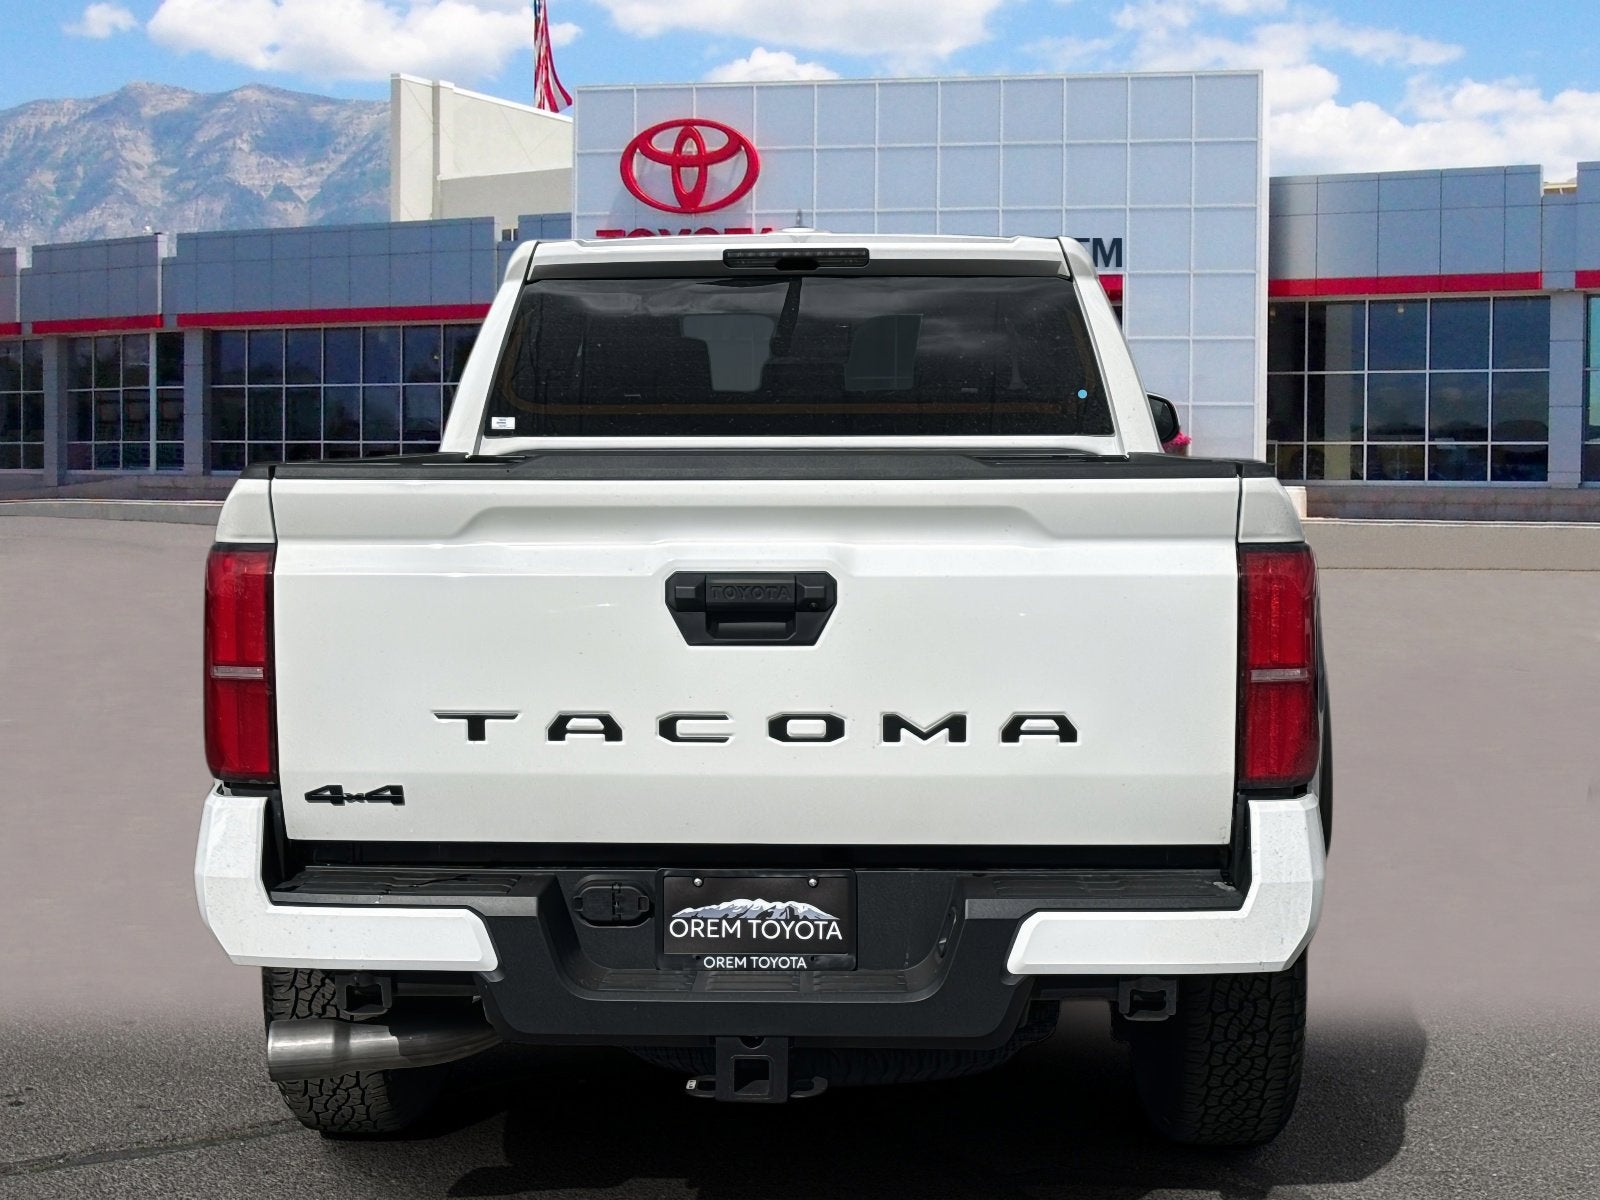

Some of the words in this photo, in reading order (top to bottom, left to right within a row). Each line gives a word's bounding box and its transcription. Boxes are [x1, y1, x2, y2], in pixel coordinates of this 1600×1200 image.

[711, 585, 792, 600] TOYOTA
[432, 710, 1080, 744] TACOMA
[669, 918, 741, 939] OREM
[747, 919, 843, 940] TOYOTA
[703, 956, 747, 969] OREM
[750, 956, 807, 970] TOYOTA
